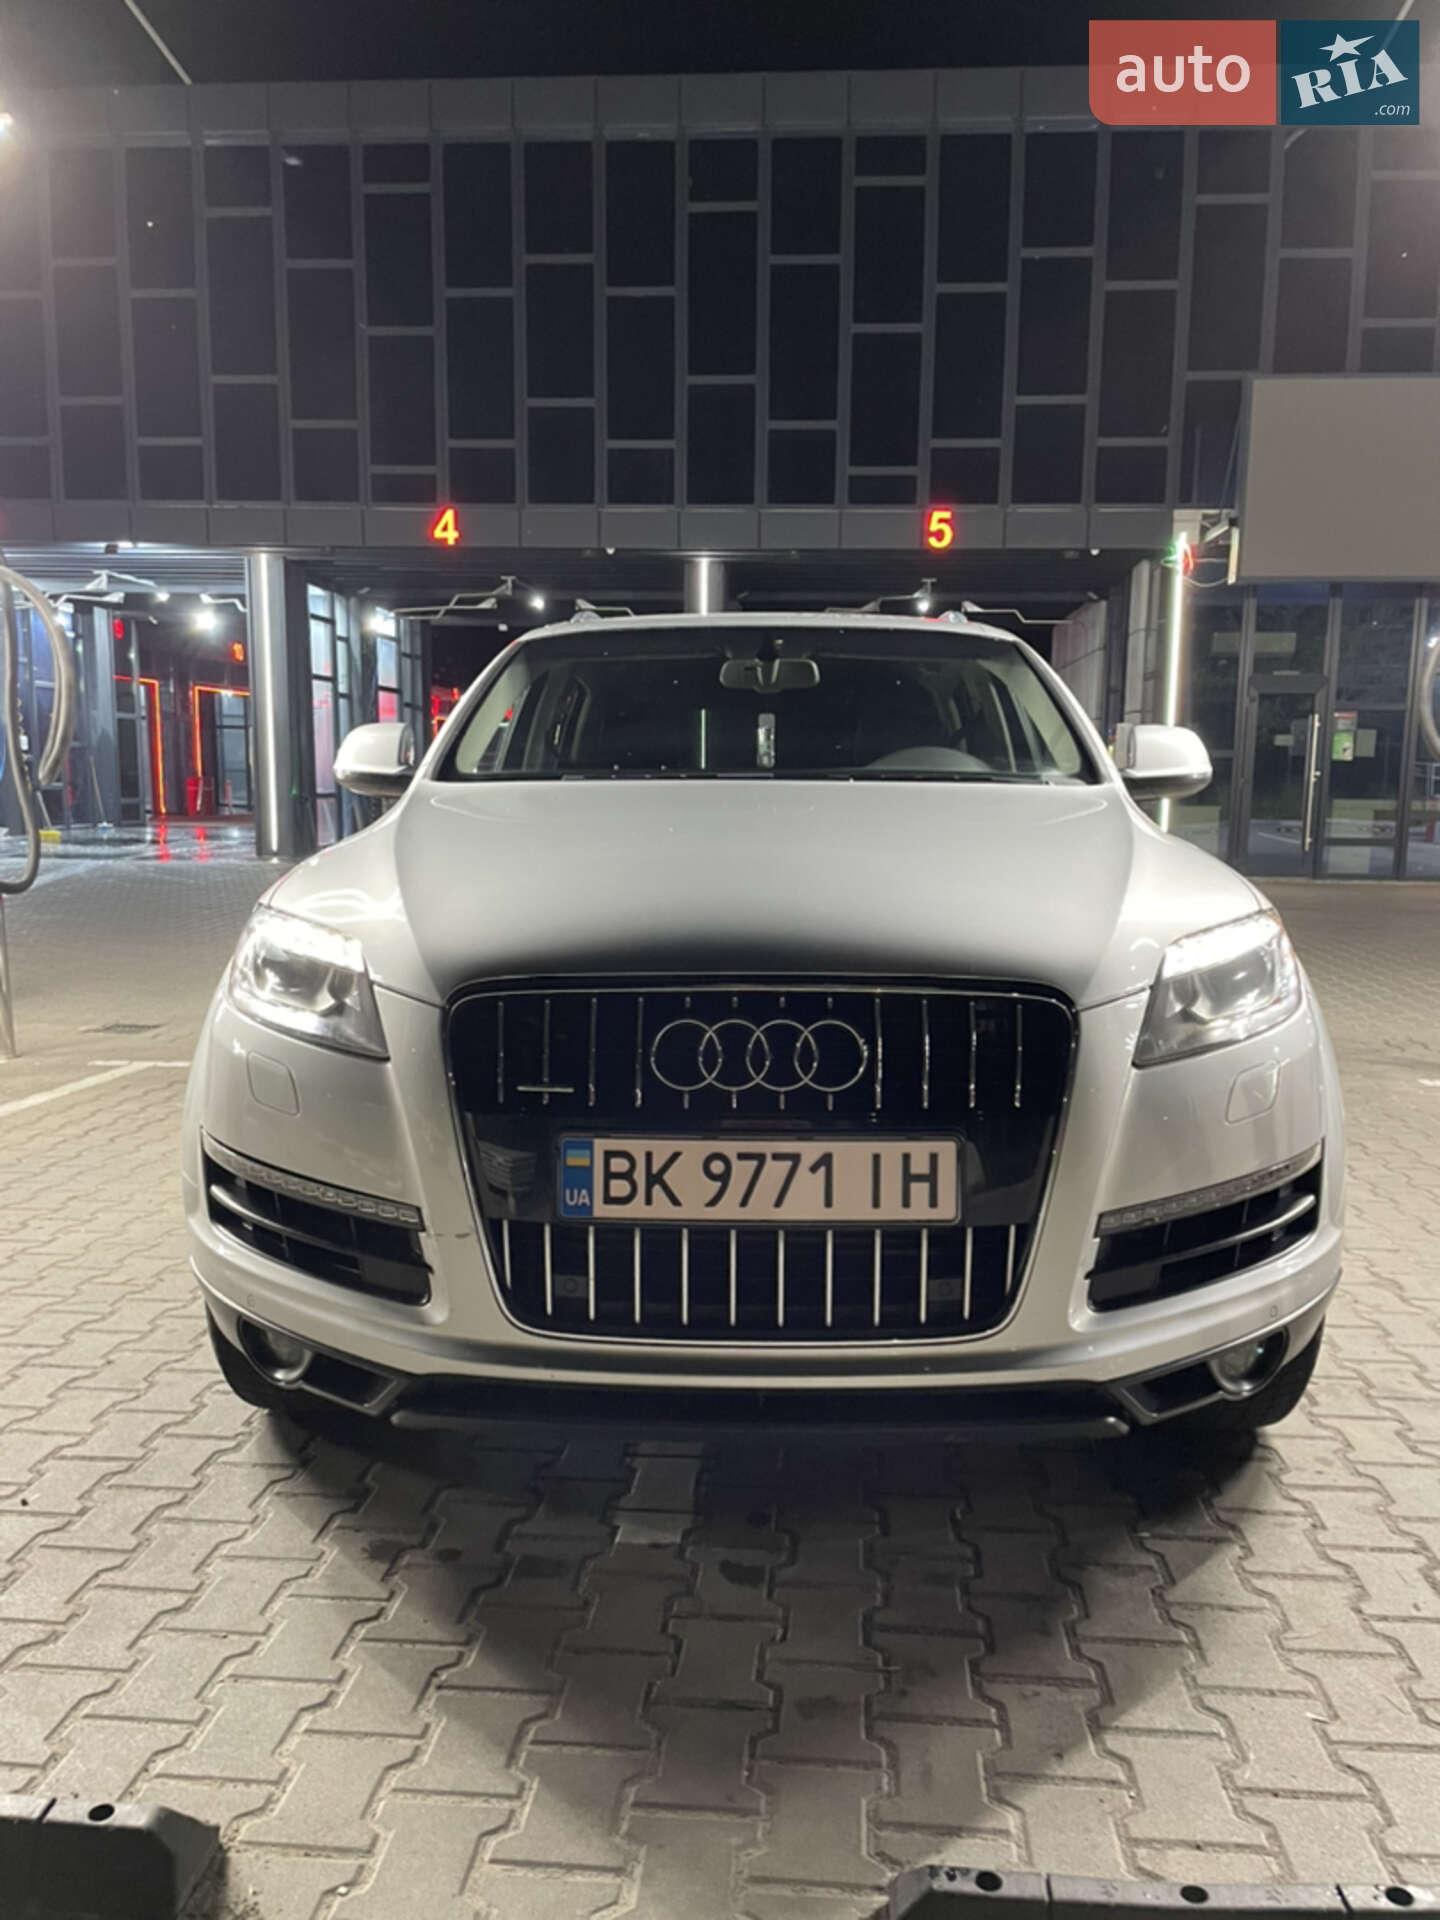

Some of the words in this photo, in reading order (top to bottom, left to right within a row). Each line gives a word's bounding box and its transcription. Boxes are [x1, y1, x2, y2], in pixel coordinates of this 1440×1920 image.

[432, 507, 460, 547] 4
[927, 509, 954, 549] 5
[565, 1188, 591, 1207] UA
[602, 1149, 683, 1207] BK
[702, 1152, 834, 1209] 9771
[871, 1152, 939, 1209] IH
